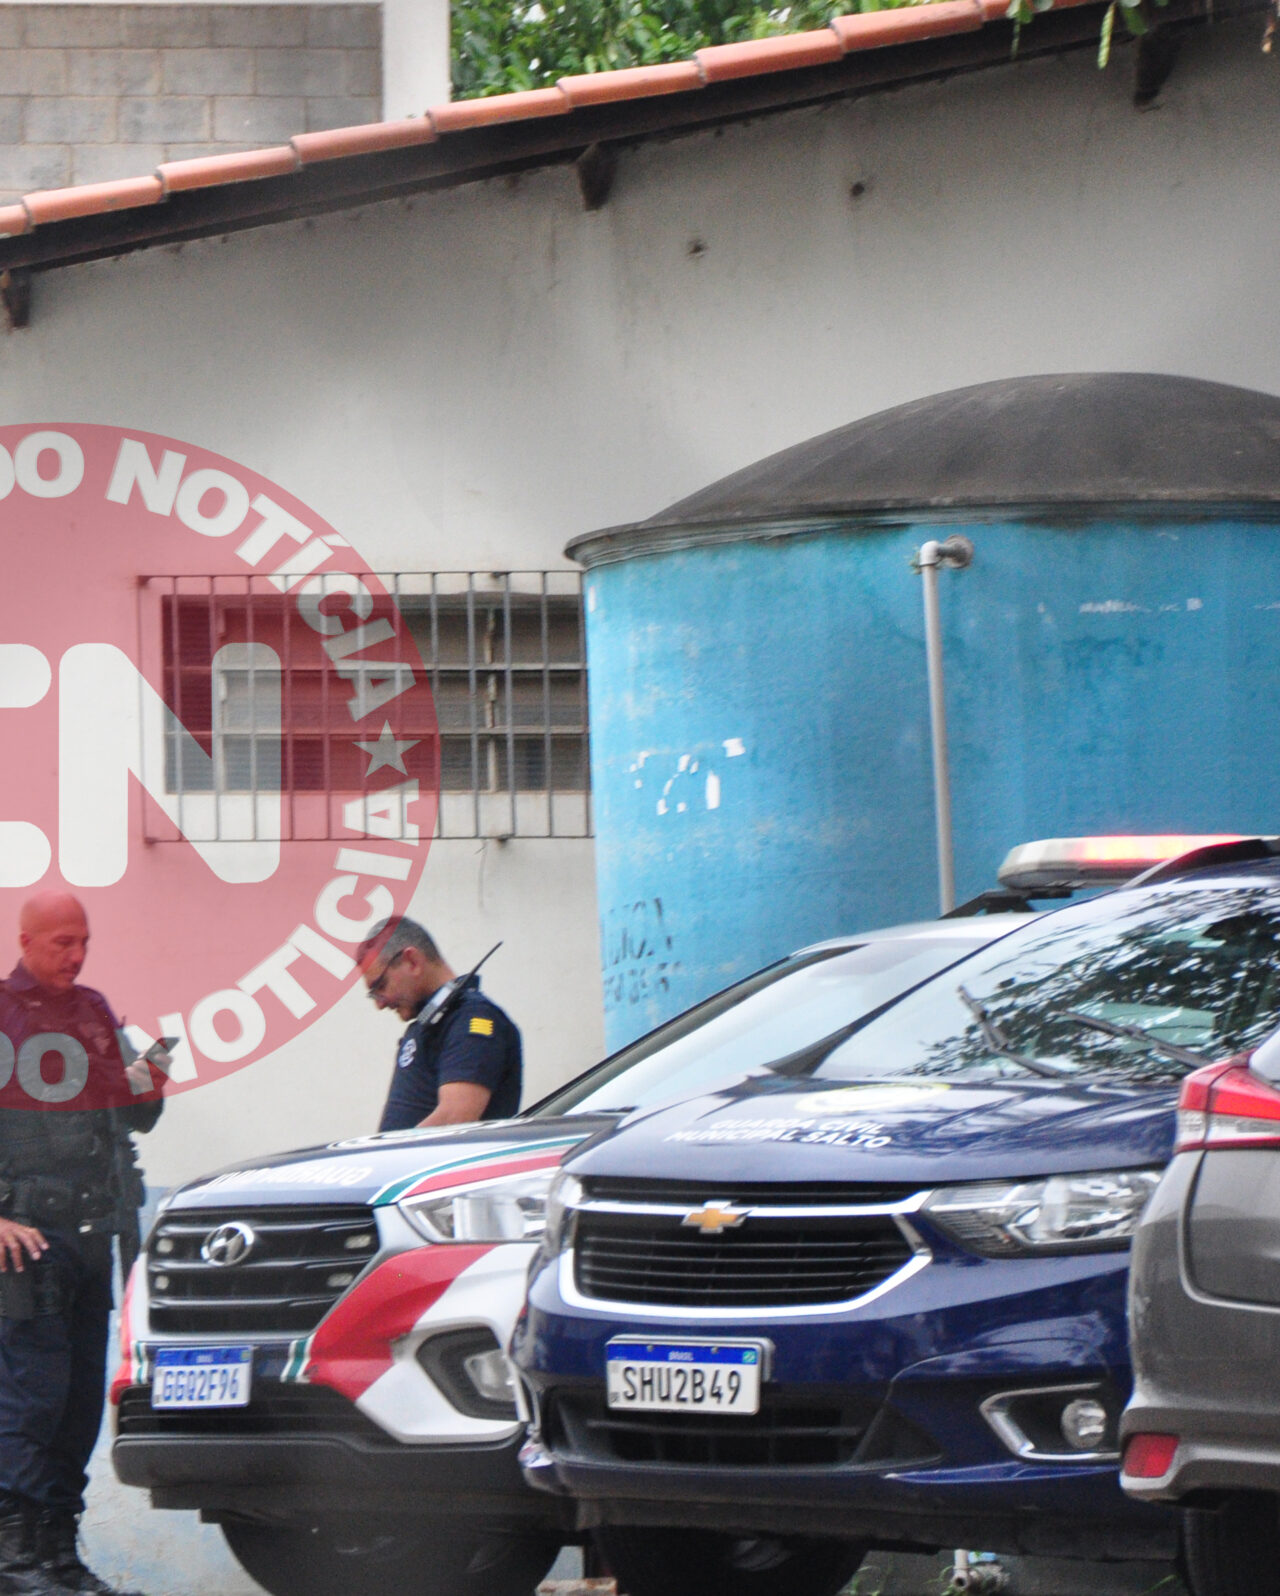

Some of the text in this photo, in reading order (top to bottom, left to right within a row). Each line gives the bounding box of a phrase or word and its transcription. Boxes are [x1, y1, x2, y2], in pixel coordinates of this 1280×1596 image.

[664, 1128, 892, 1148] MUNICIPAL SALTO
[710, 1118, 886, 1135] GUARDA CIVIL
[163, 1367, 239, 1401] GGQ2F96
[623, 1366, 741, 1405] SHU2B49
